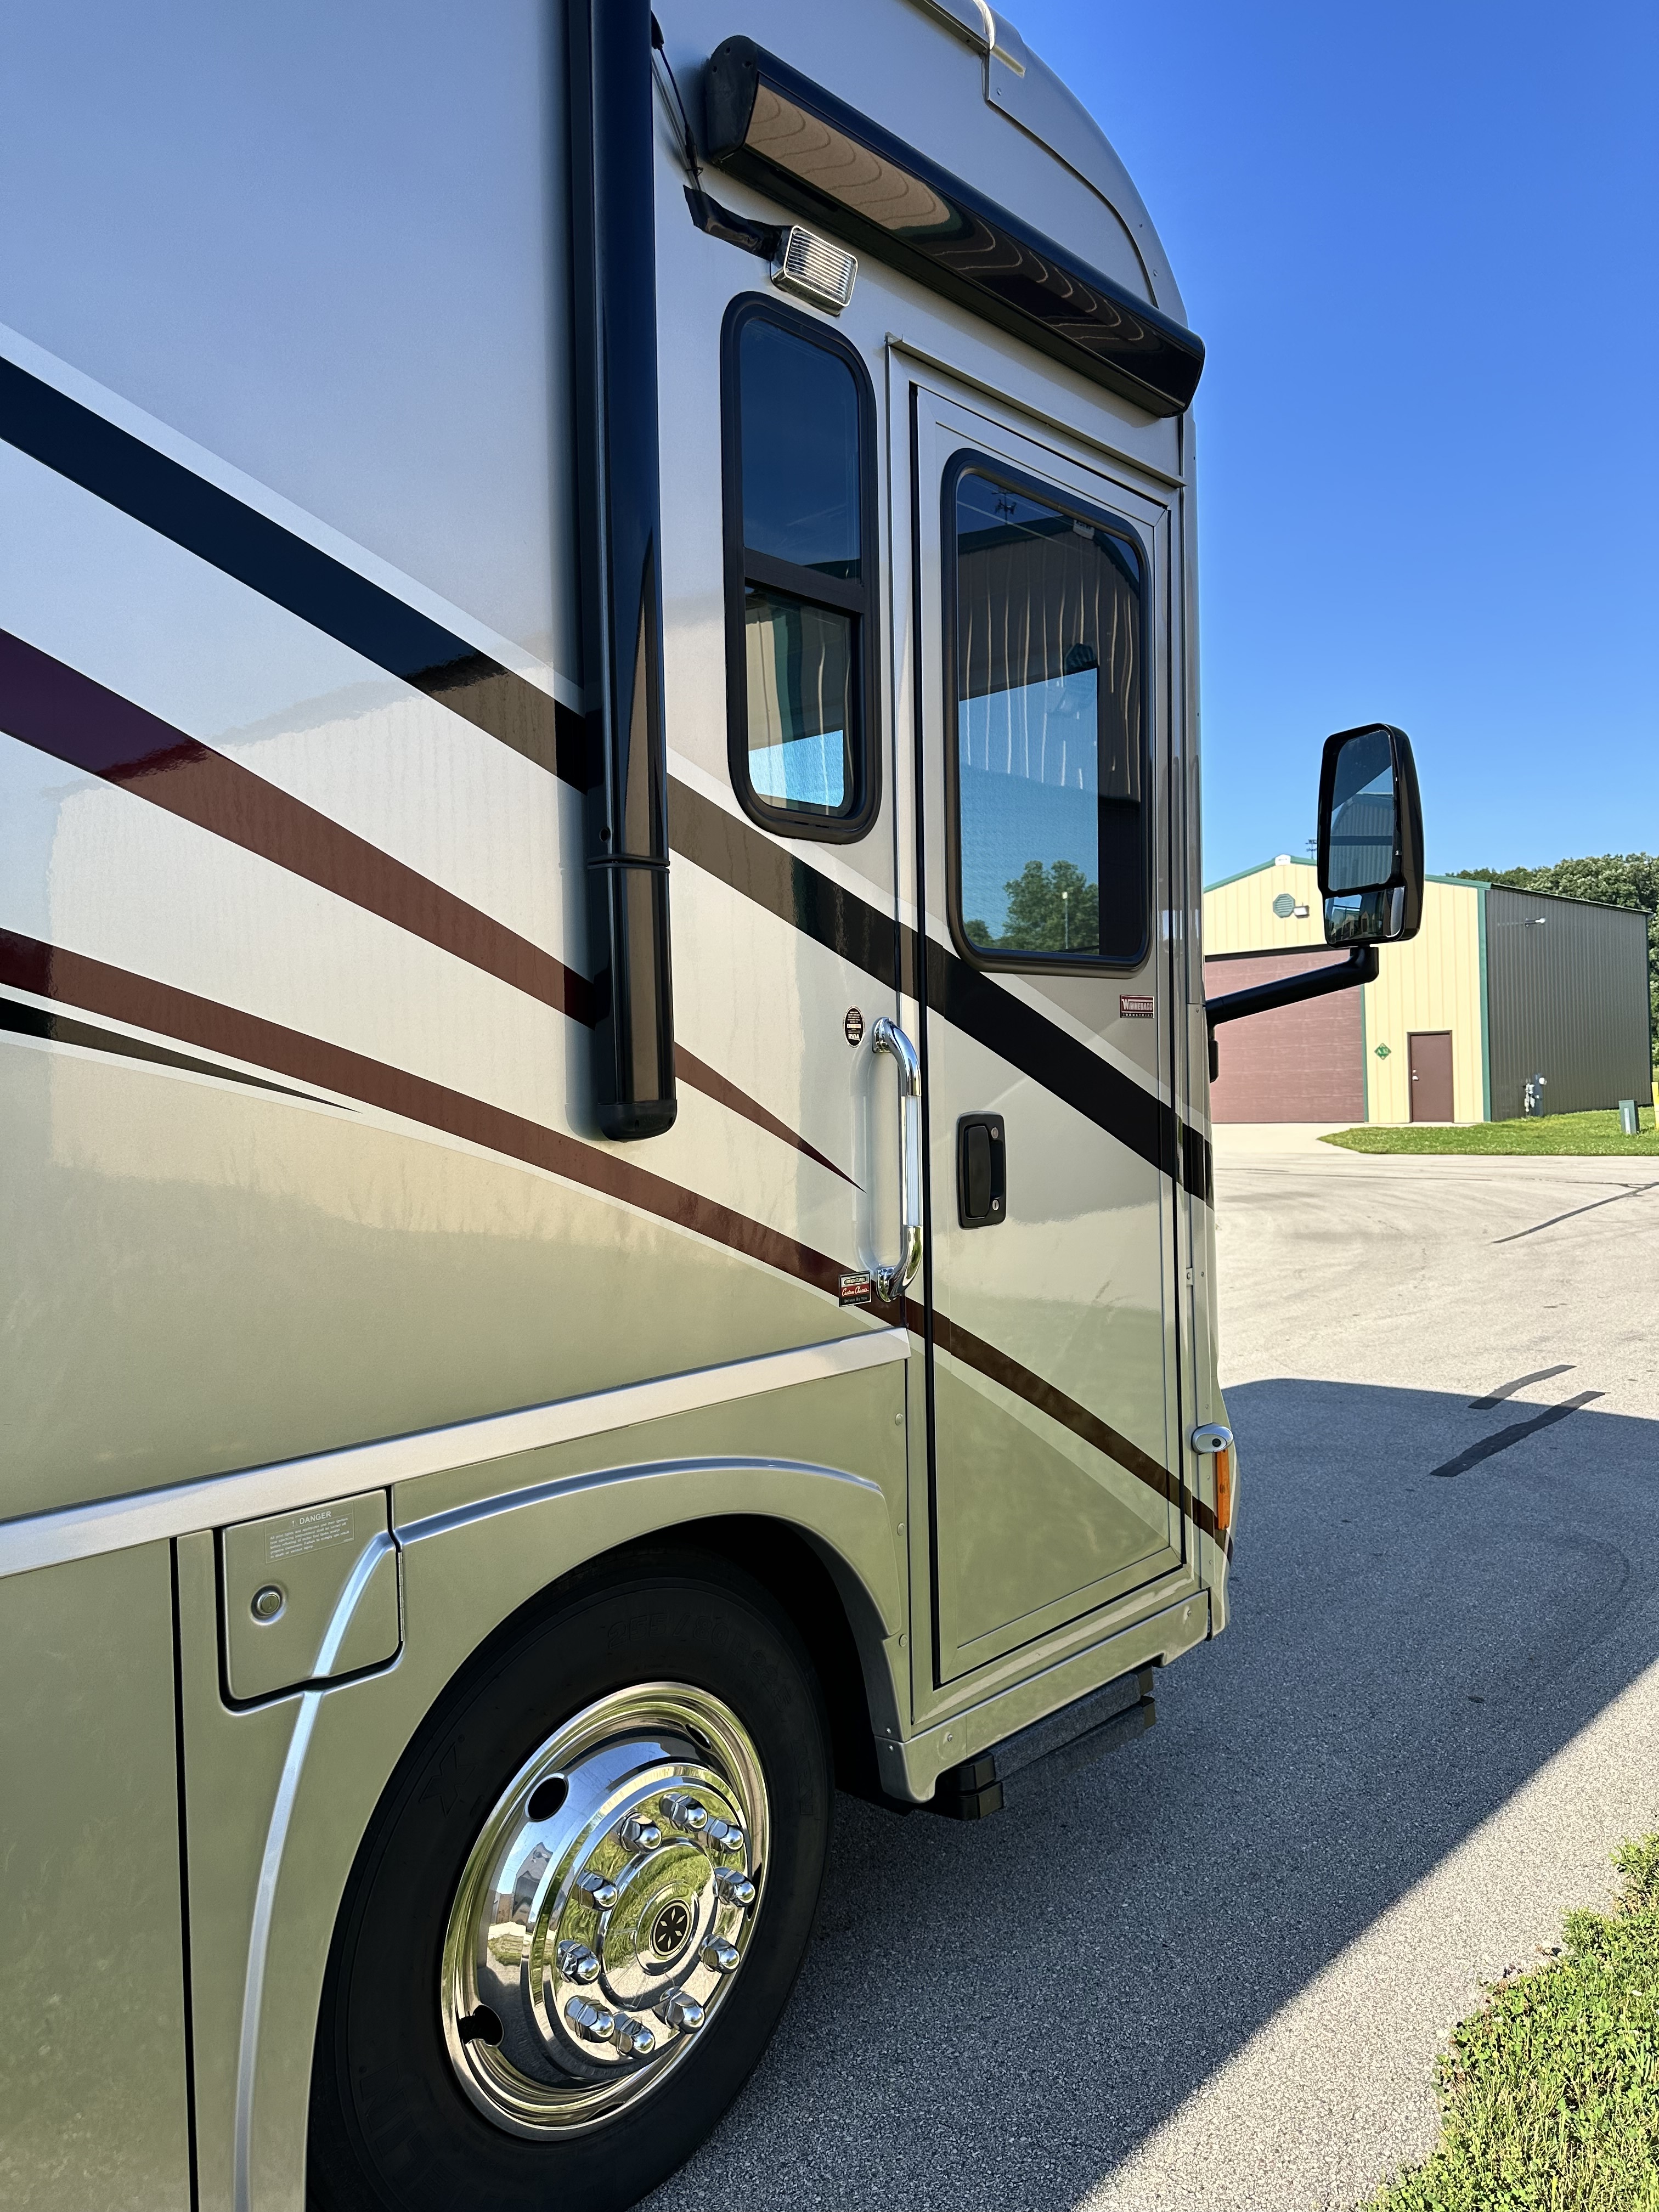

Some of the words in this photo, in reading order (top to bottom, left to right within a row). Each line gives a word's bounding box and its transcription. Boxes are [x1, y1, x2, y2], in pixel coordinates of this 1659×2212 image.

[1121, 998, 1153, 1011] WINNEBAGO
[842, 1288, 855, 1296] Custom
[300, 1511, 331, 1525] DANGER
